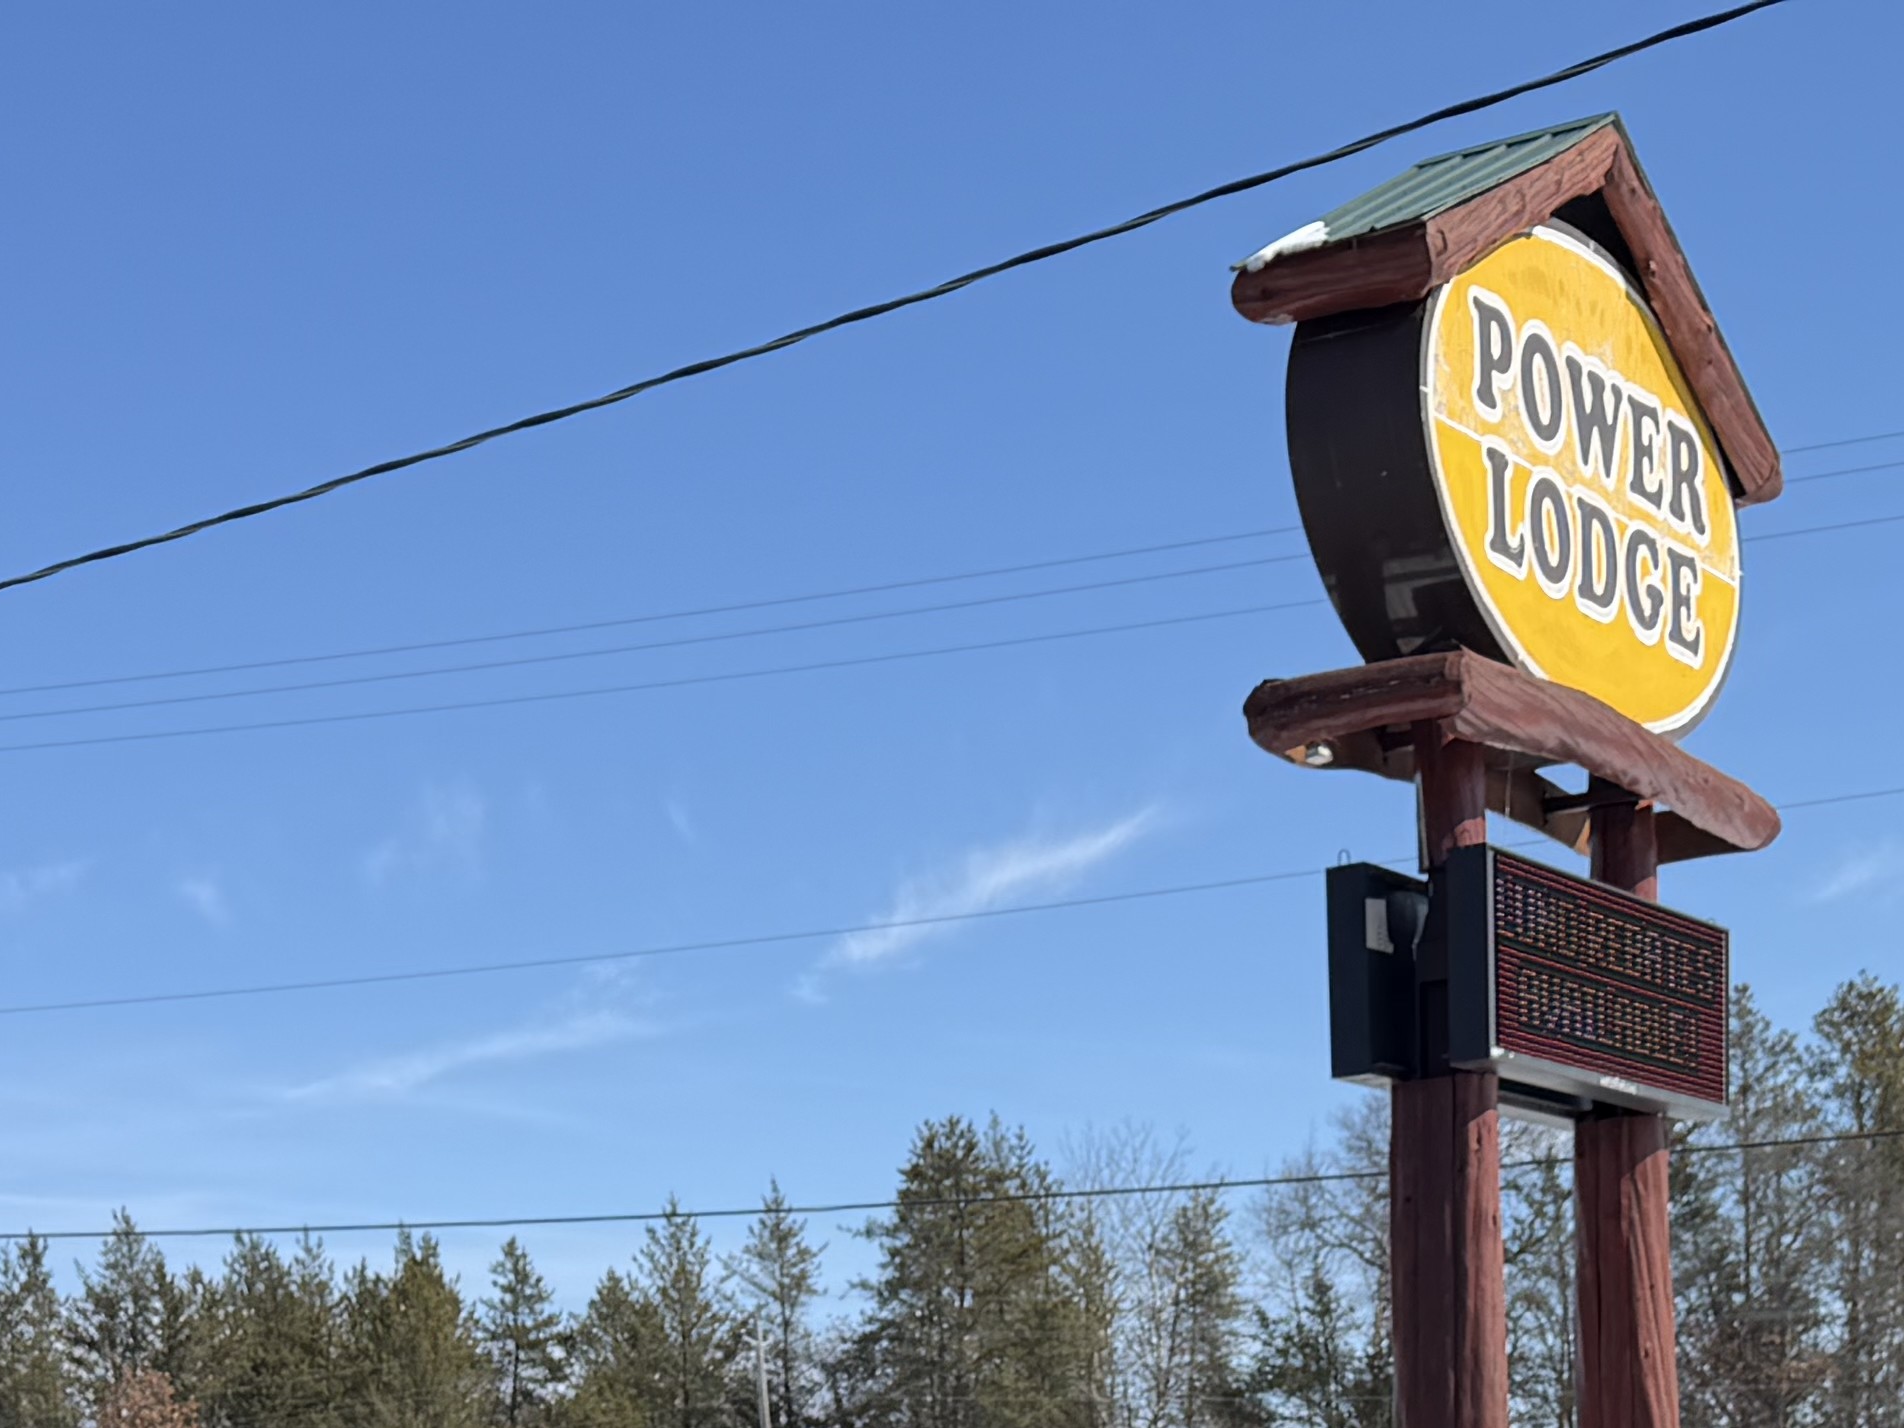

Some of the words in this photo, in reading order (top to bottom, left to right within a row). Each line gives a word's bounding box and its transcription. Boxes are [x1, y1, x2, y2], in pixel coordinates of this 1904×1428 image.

[1471, 290, 1707, 541] POWER
[1484, 441, 1702, 664] LODGE
[1587, 909, 1715, 1001] REBATES
